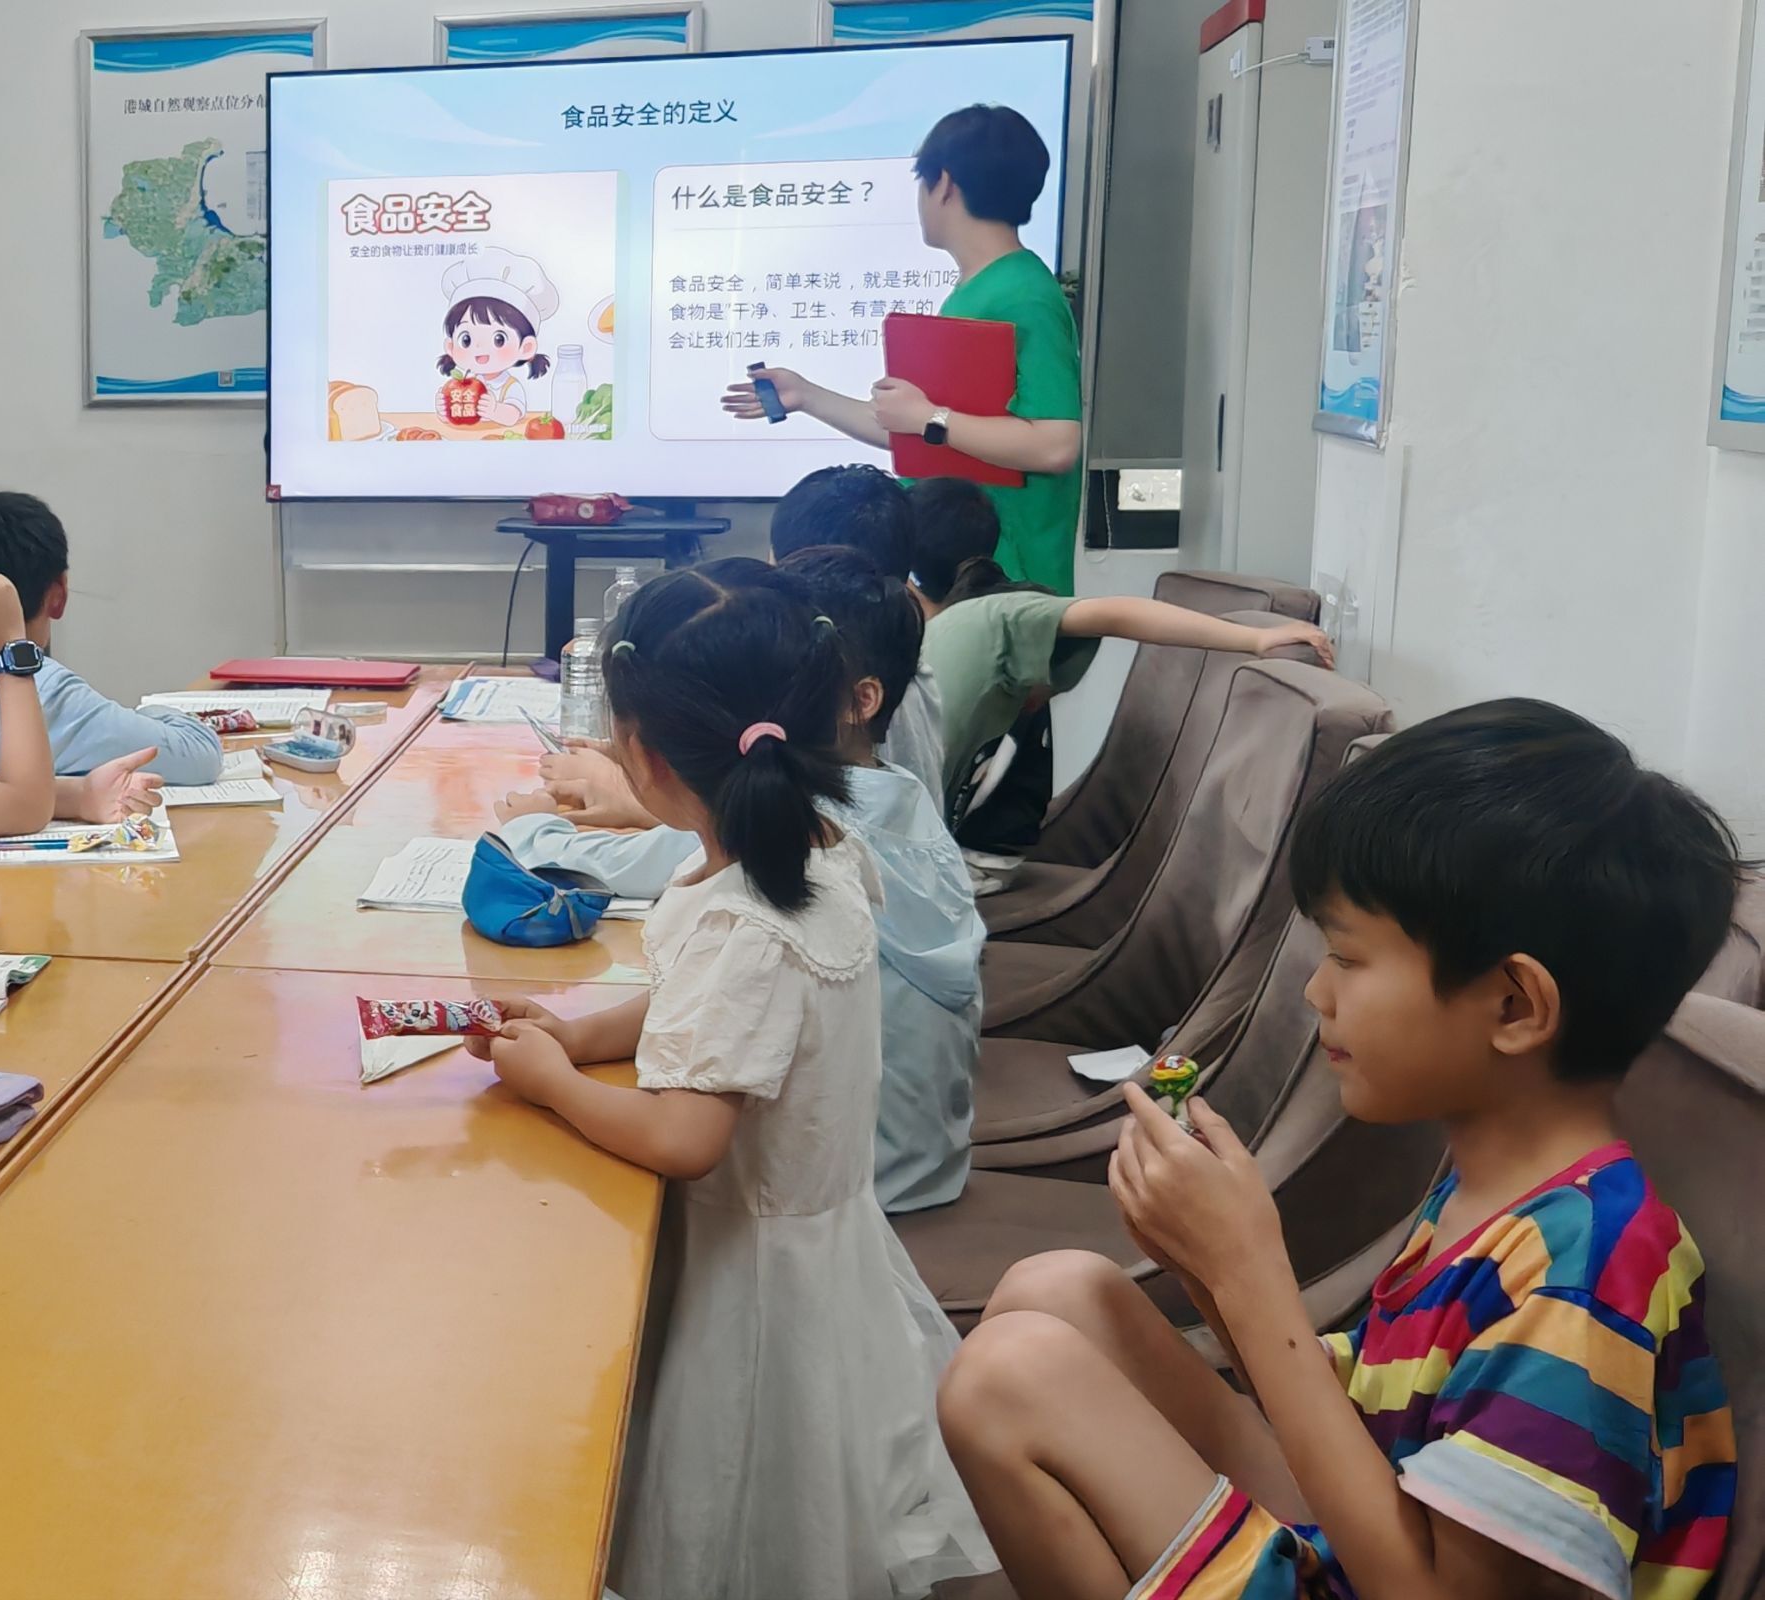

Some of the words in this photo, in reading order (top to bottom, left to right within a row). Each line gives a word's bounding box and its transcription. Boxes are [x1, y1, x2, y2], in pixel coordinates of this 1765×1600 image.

[560, 98, 738, 130] 食品安全的定义
[671, 180, 875, 211] 什么是食品安全？
[341, 190, 492, 236] 食品安全
[349, 242, 479, 258] 安全的食物让我们健康成长
[668, 328, 885, 350] 会让我们生病，能让我们
